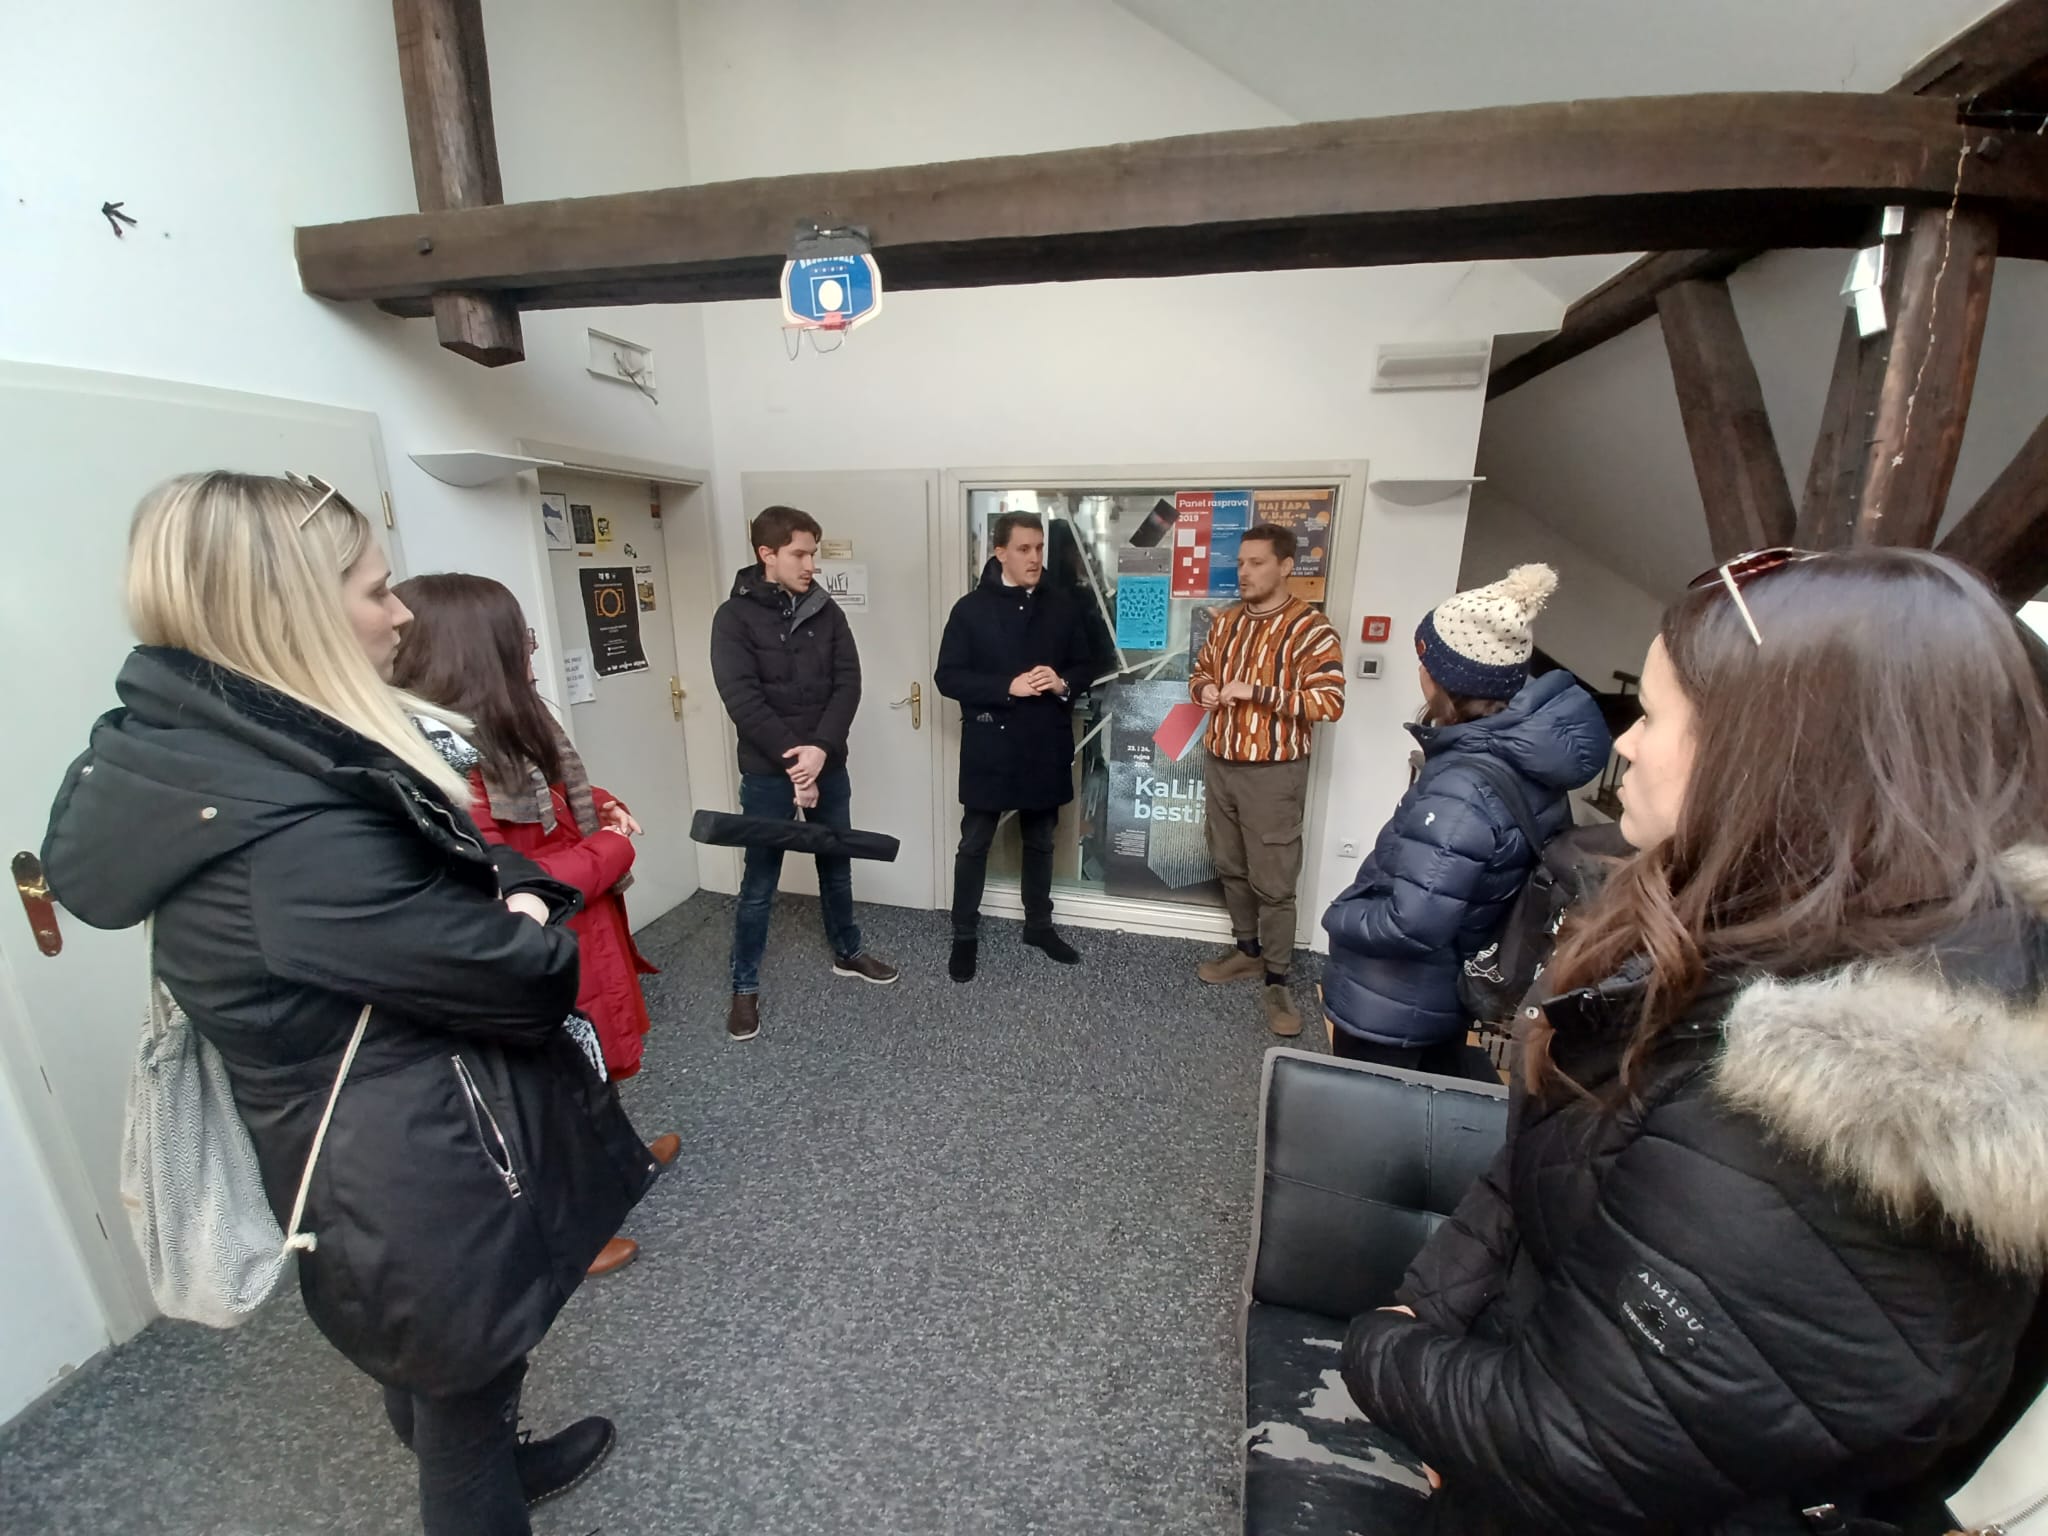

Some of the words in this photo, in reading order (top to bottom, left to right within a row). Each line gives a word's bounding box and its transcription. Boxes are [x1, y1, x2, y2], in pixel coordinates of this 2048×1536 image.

[1179, 499, 1206, 508] Panel
[1207, 499, 1249, 508] rasprava
[1134, 799, 1205, 824] besti
[1637, 1271, 1704, 1331] AMISU
